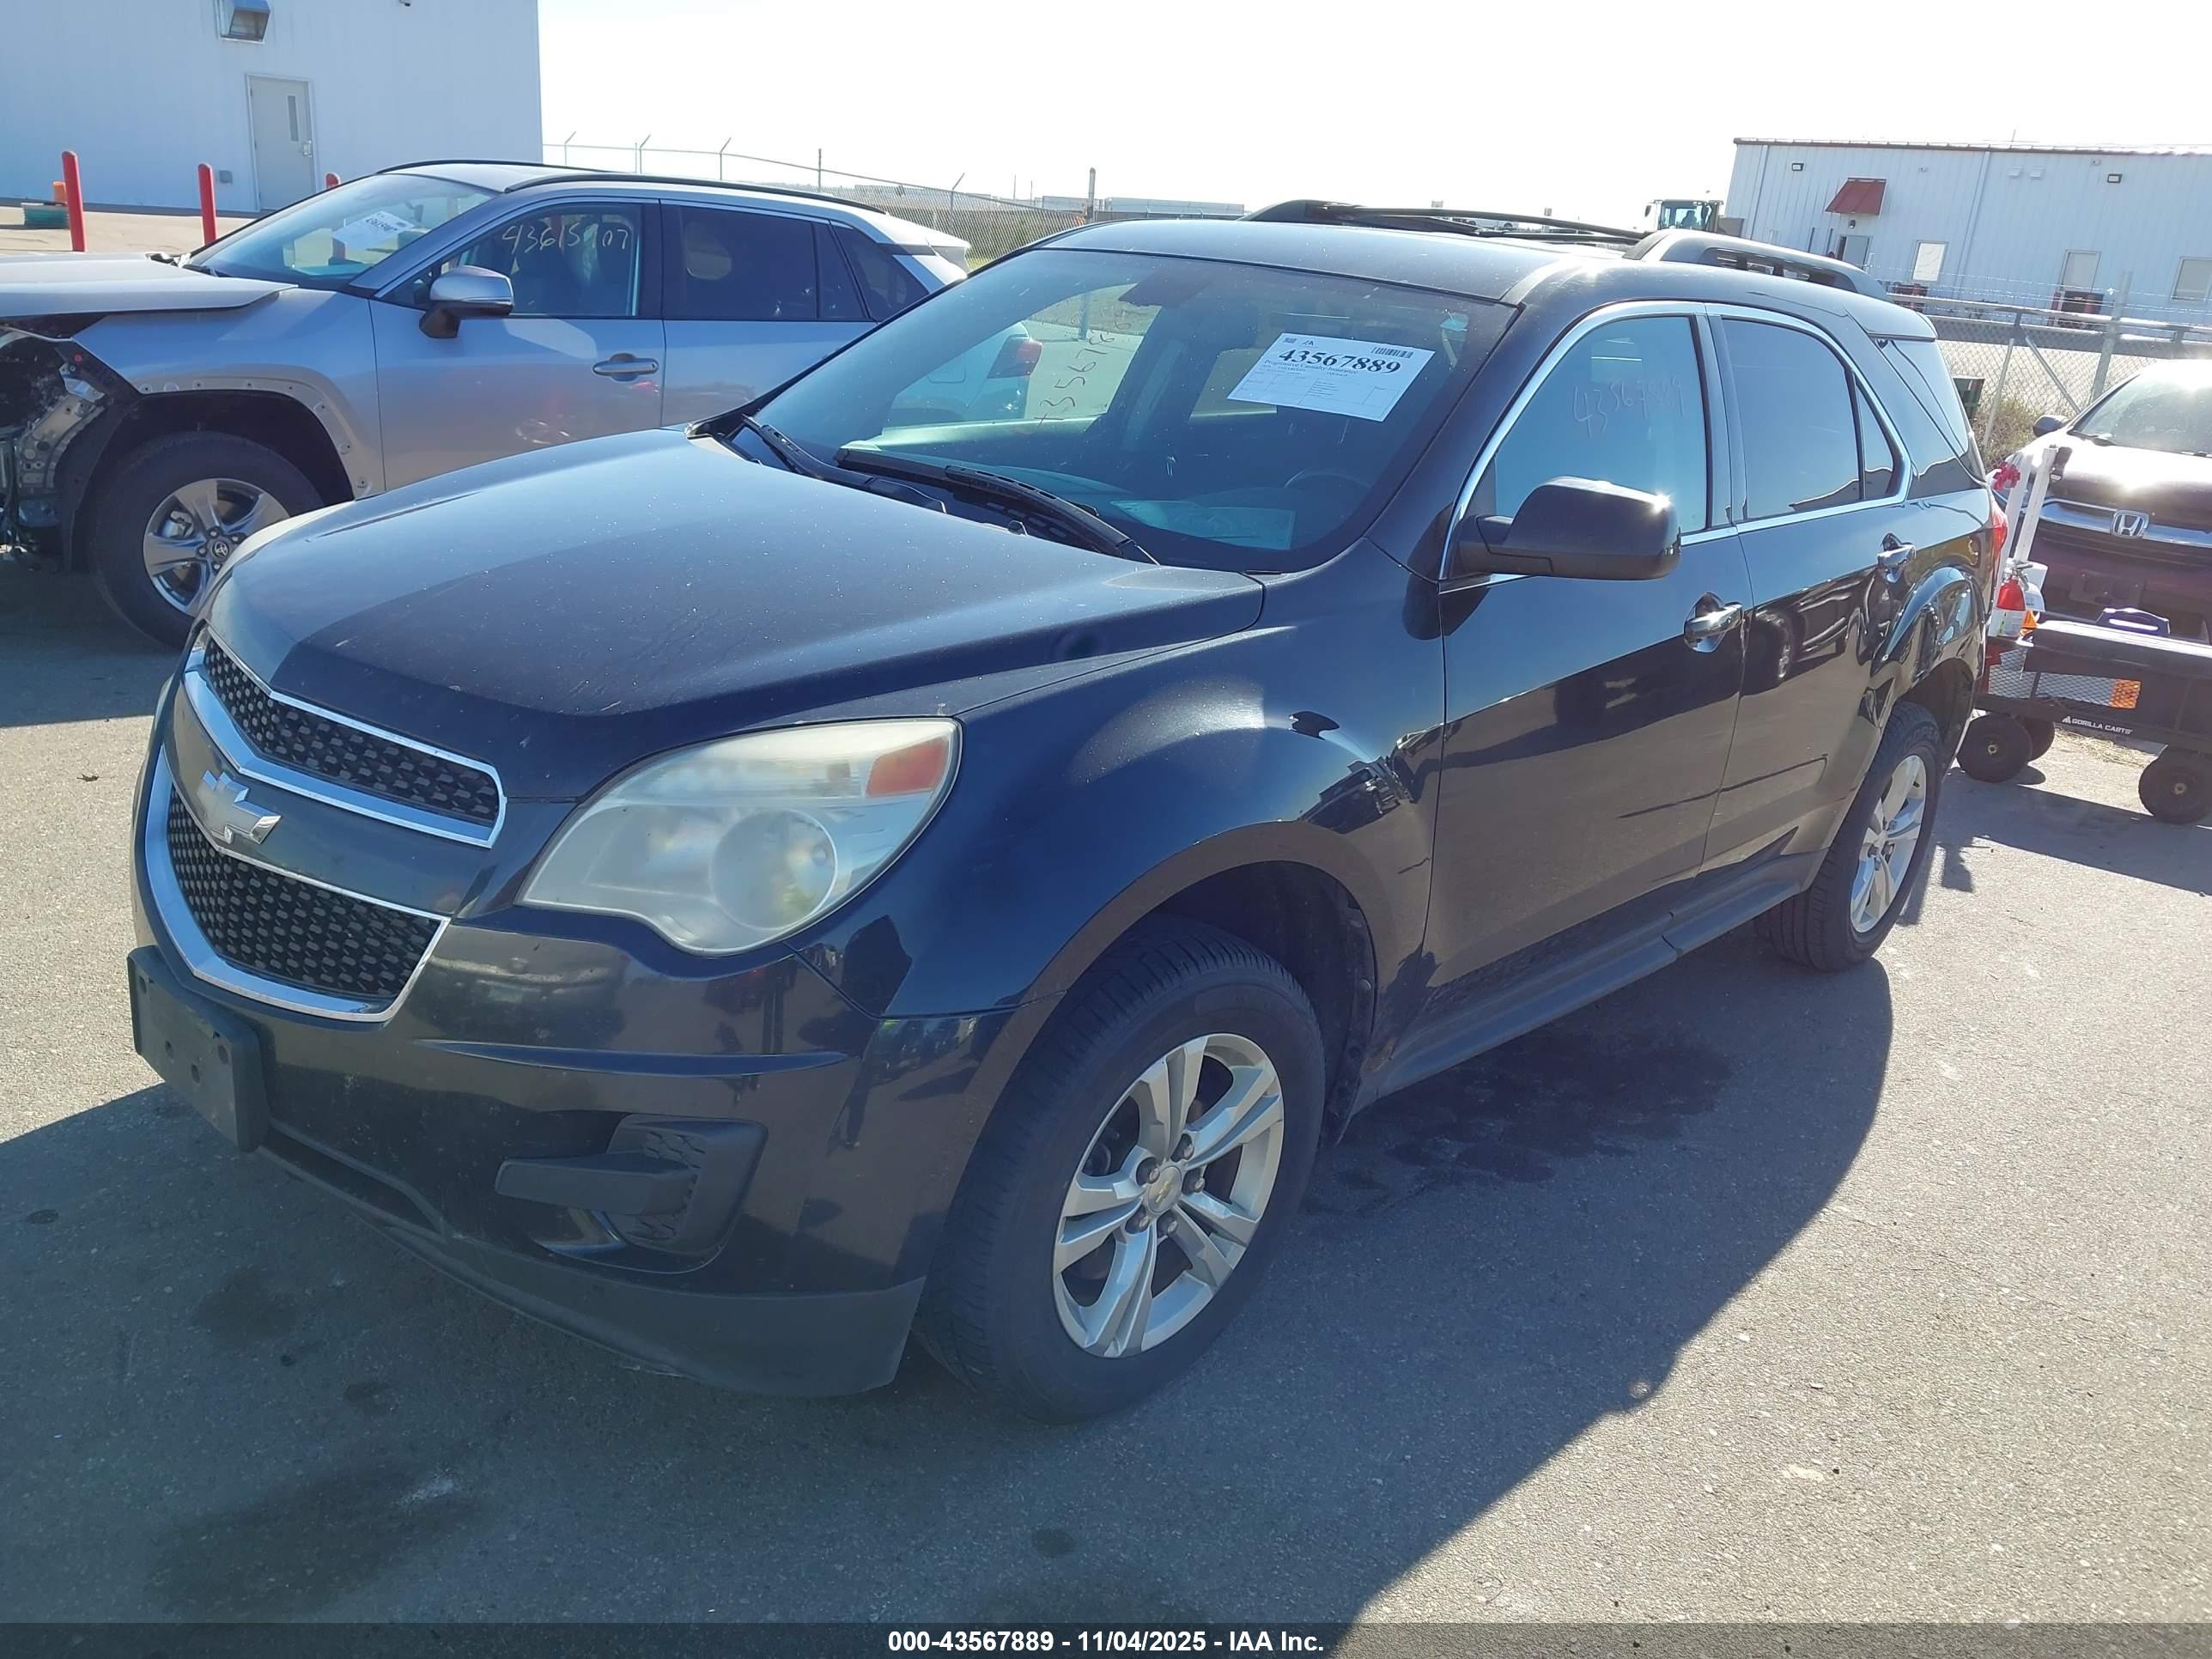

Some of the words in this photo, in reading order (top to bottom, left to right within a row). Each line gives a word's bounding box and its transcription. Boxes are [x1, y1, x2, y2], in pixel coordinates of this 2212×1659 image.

[1279, 349, 1401, 374] 43567889
[2071, 718, 2103, 730] GORILLA
[2104, 724, 2131, 735] CARTS
